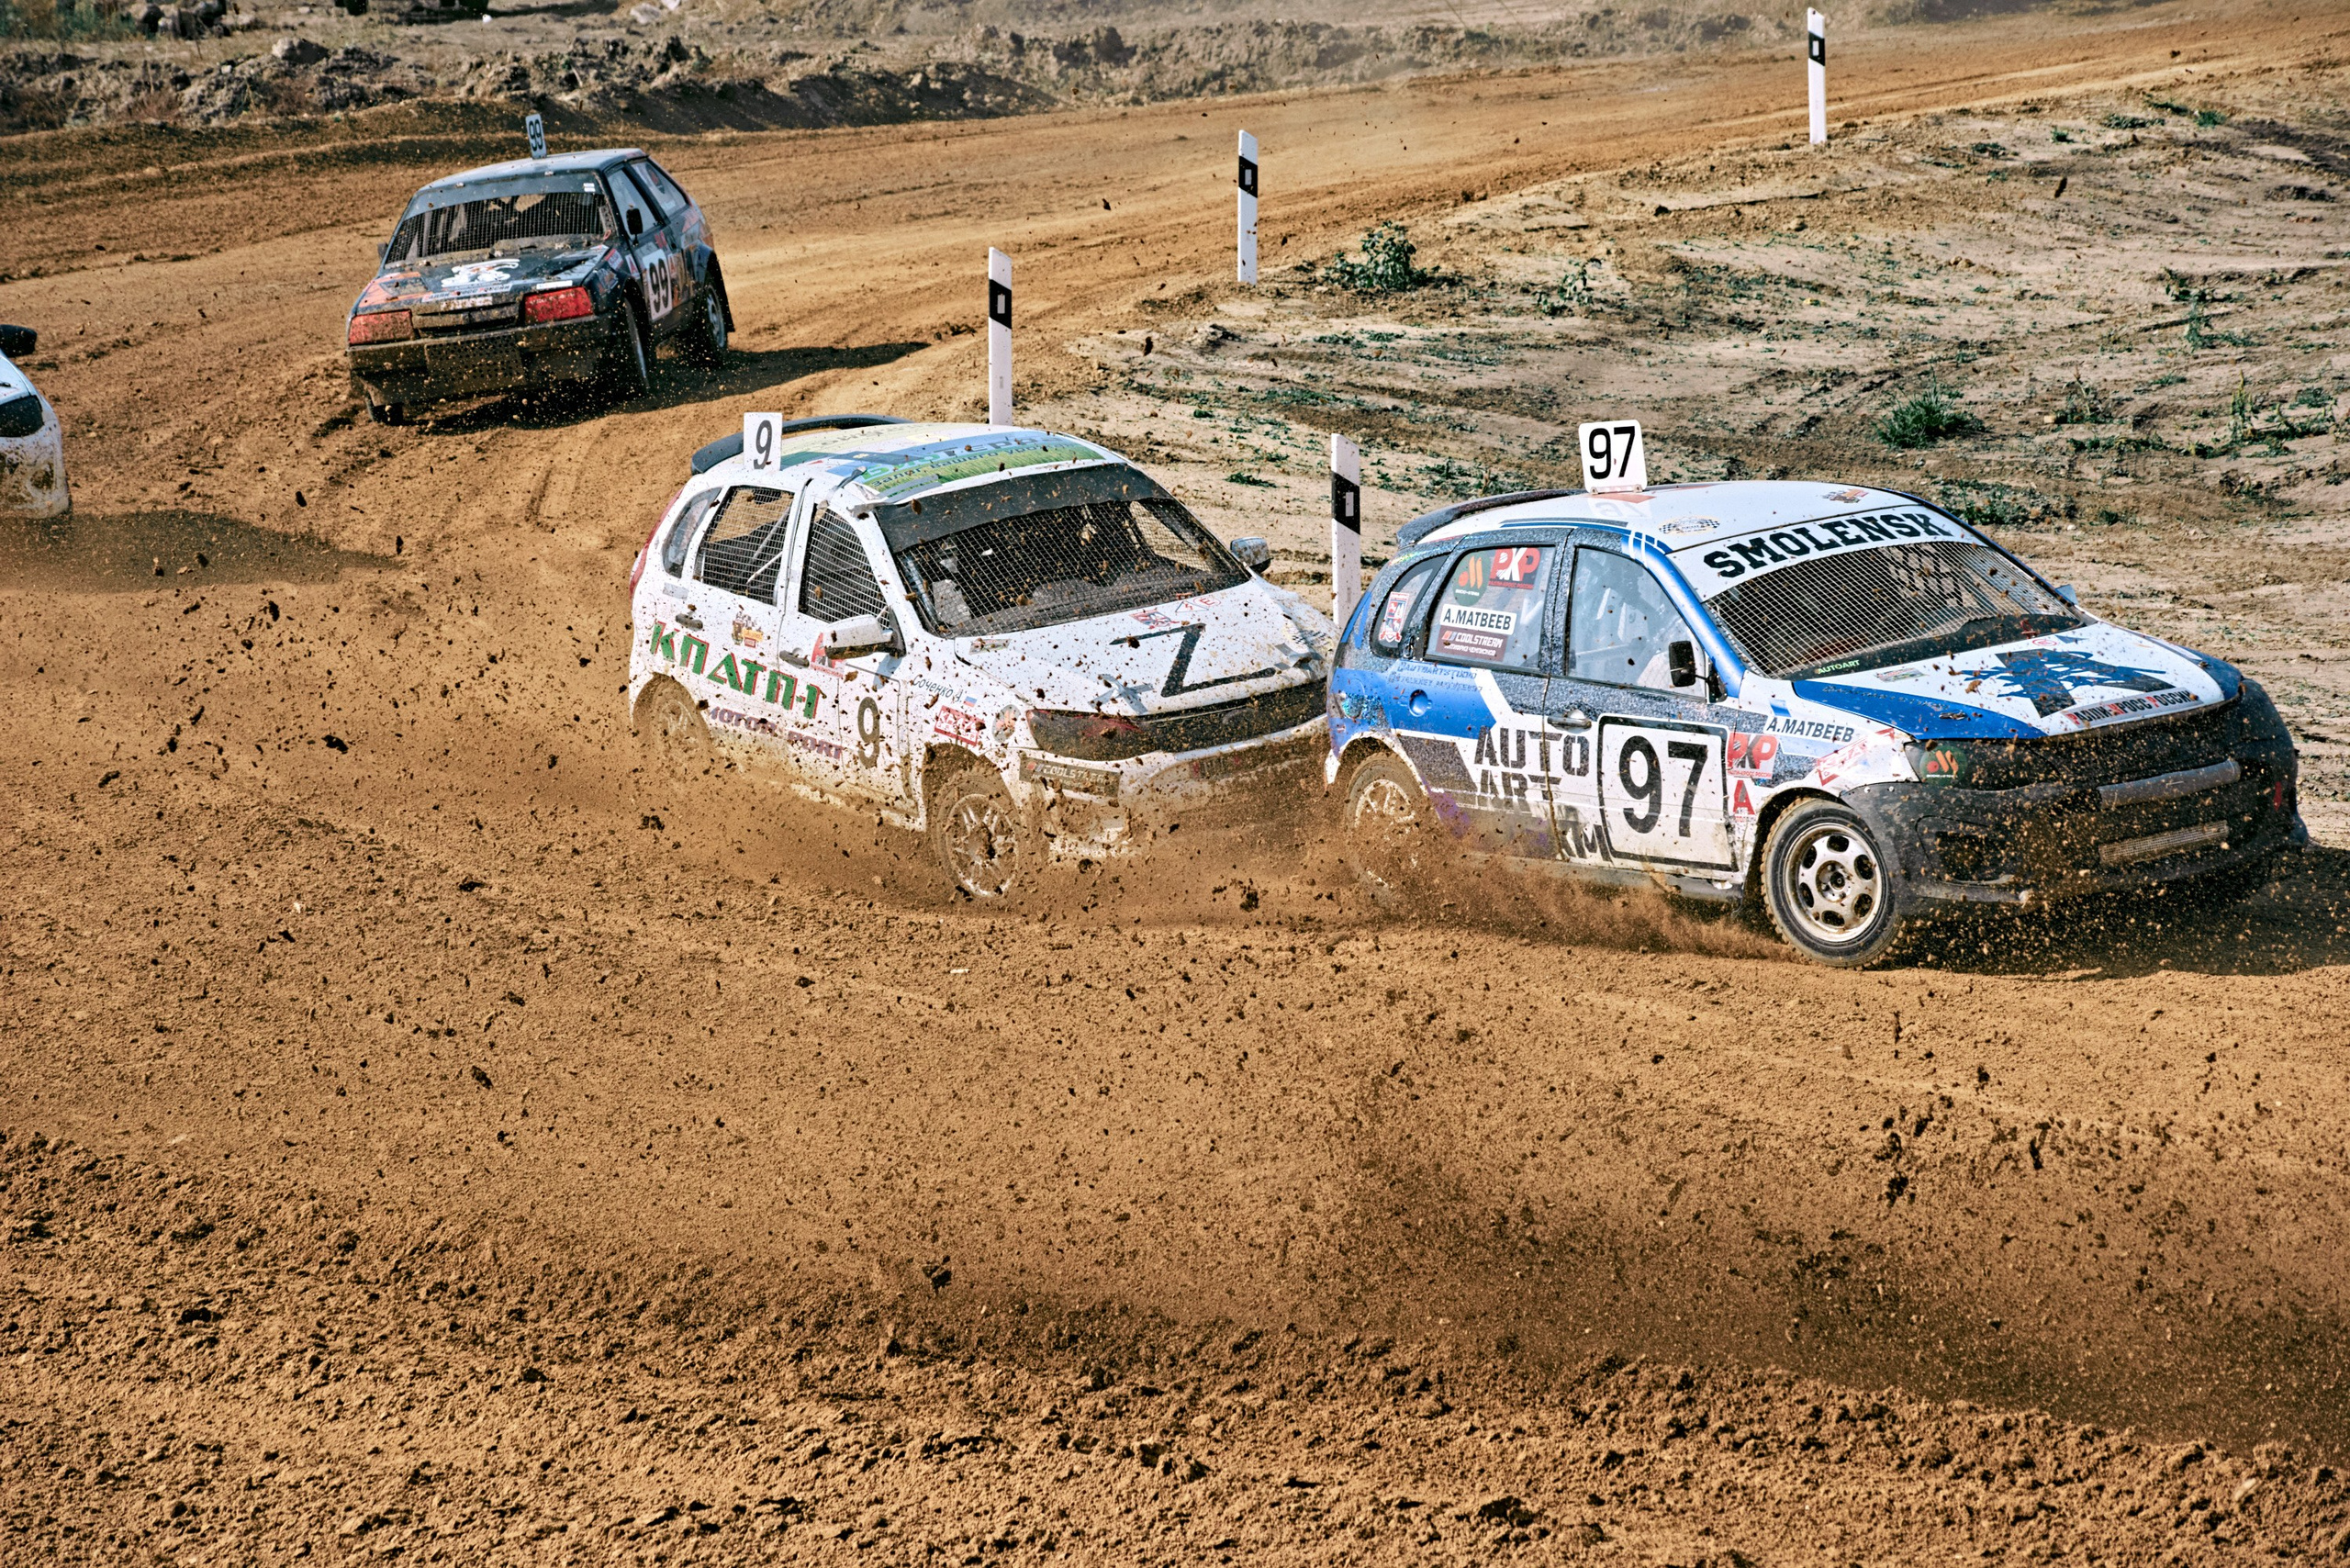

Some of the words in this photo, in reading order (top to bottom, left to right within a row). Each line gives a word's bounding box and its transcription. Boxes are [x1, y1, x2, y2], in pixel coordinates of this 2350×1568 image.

[528, 118, 545, 152] 99
[649, 258, 670, 313] 99
[753, 420, 773, 470] 9
[1587, 426, 1637, 479] 97
[1703, 512, 1953, 578] SMOLENSK
[1454, 631, 1504, 649] COOLSTREAM
[650, 621, 822, 720] КПАТП-1
[1817, 659, 1862, 676] AUTOART
[857, 697, 880, 769] 9
[1473, 726, 1590, 777] AUTO
[1618, 734, 1708, 838] 97
